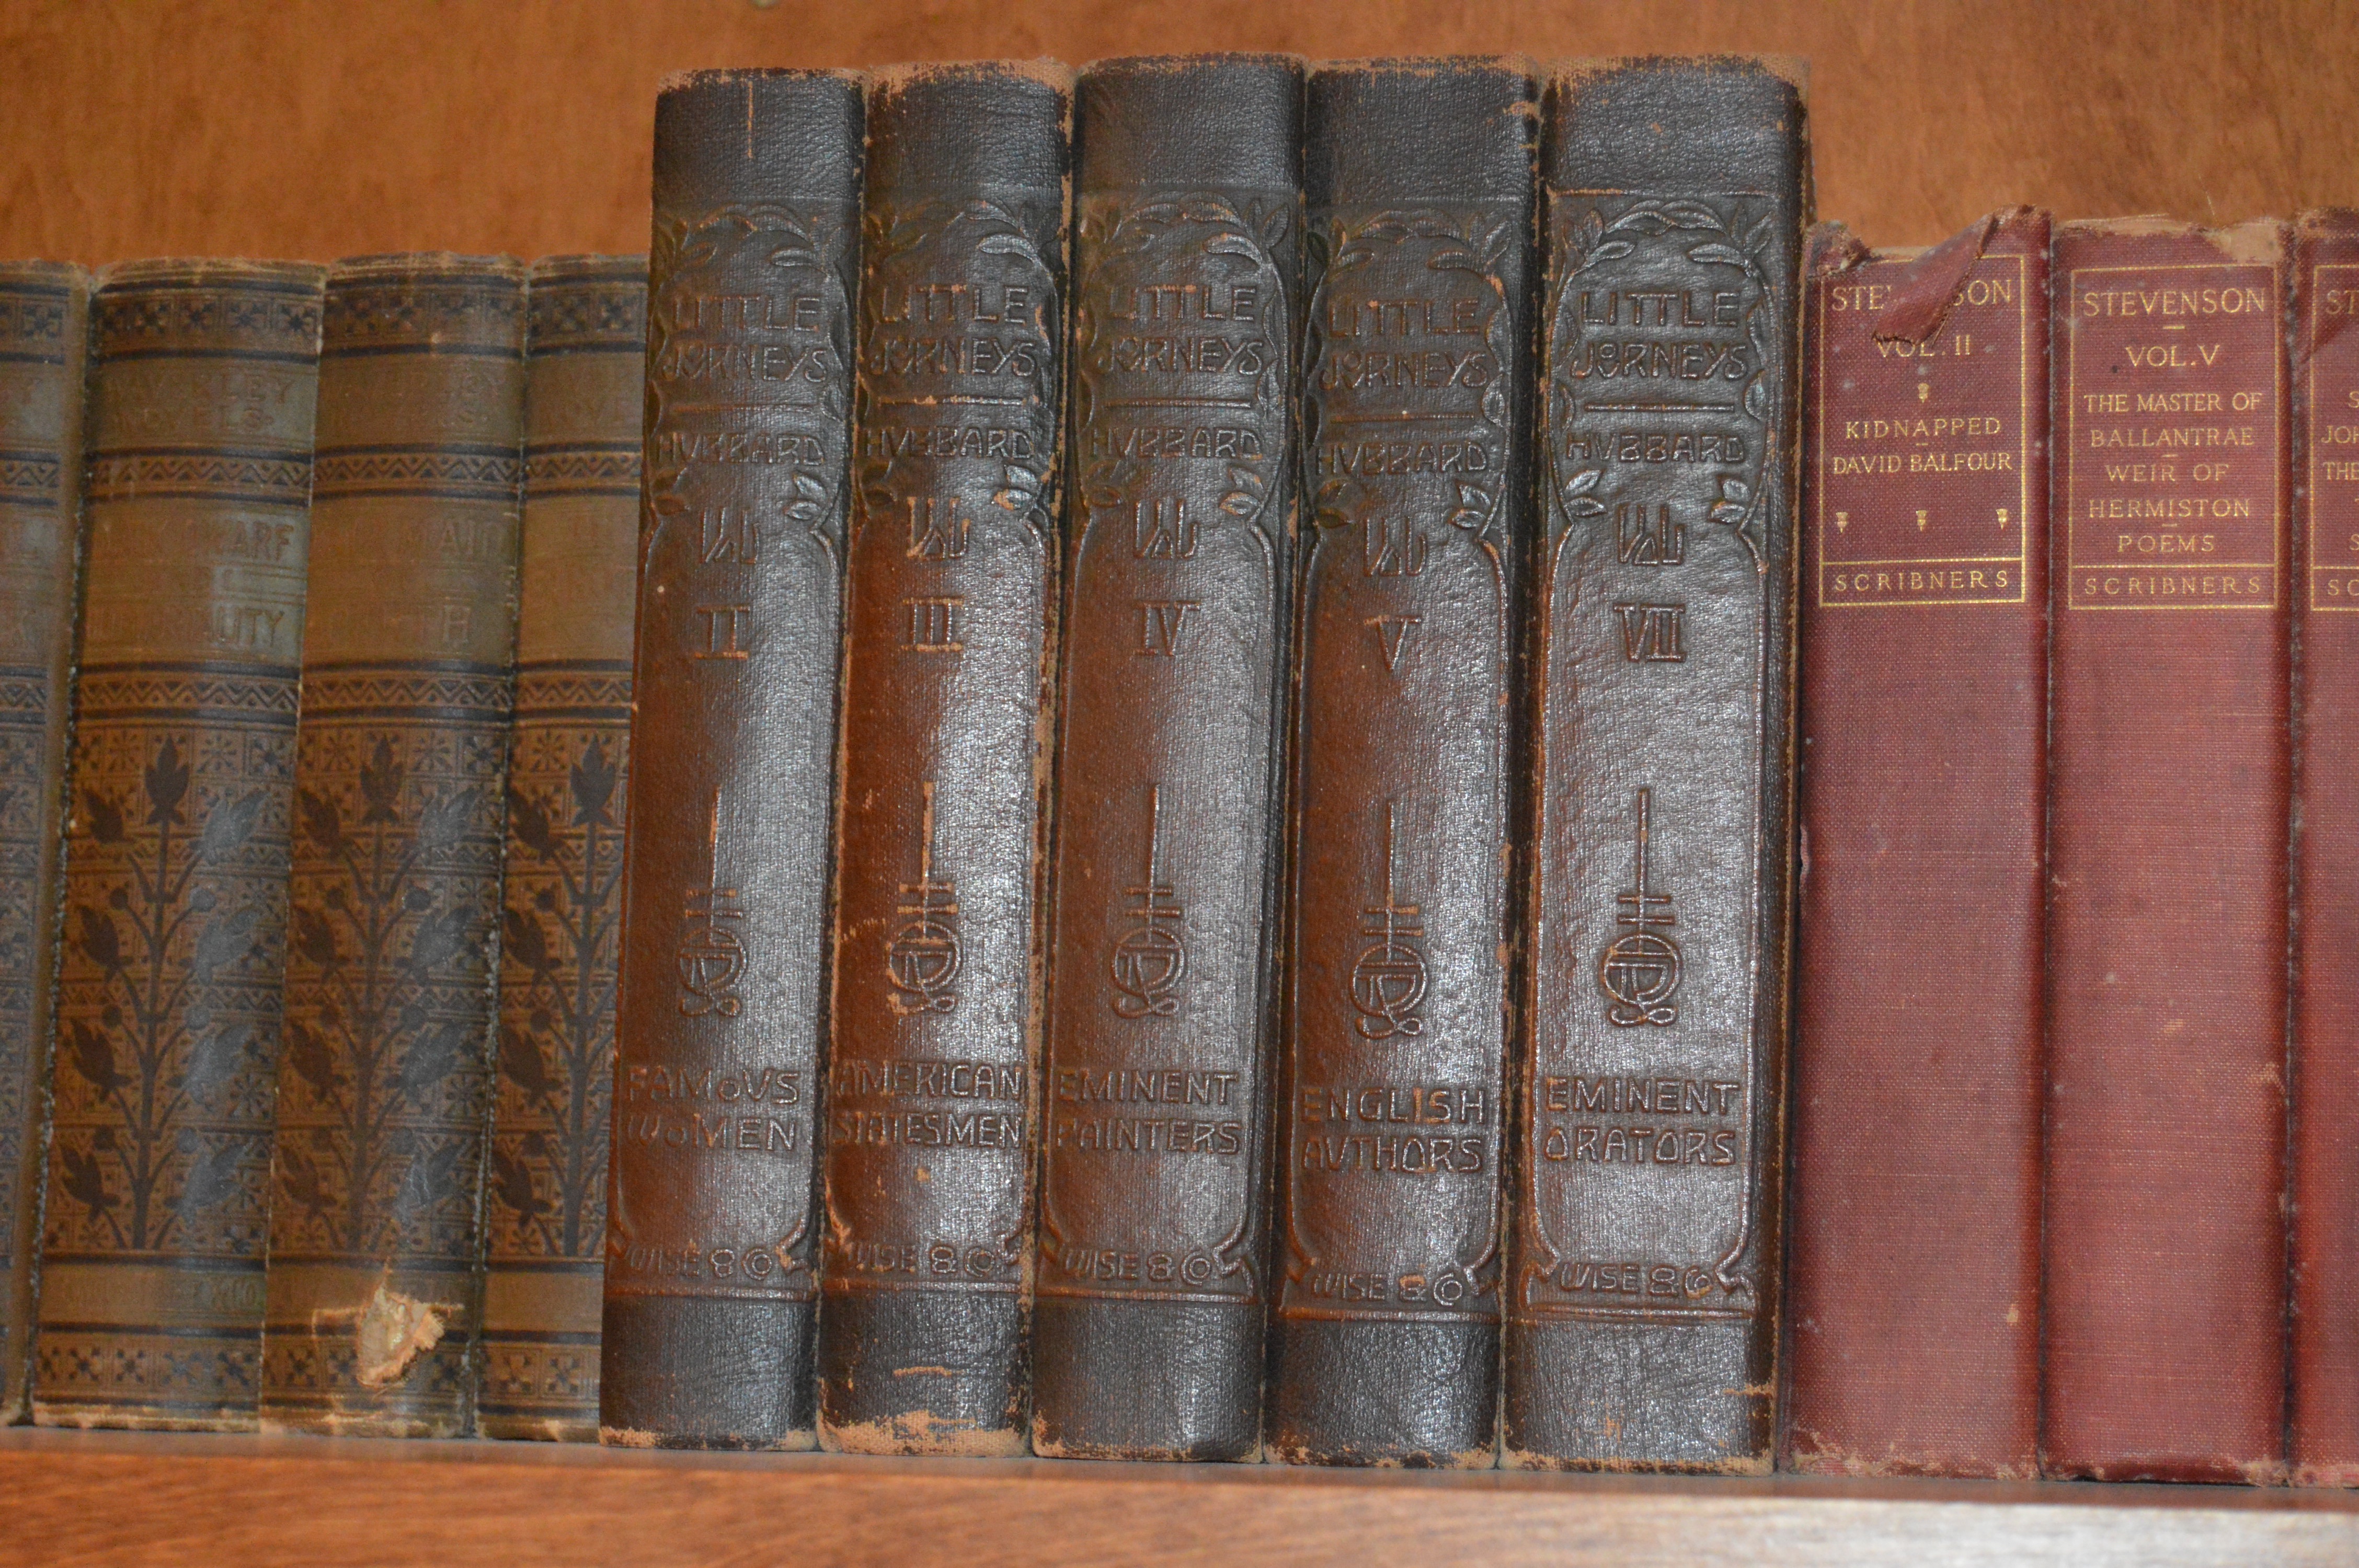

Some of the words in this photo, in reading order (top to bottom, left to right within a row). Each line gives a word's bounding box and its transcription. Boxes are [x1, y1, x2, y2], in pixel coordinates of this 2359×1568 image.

[671, 295, 821, 335] LITTLE
[880, 284, 1029, 327] LITTLE
[1109, 284, 1256, 322] LITTLE
[1327, 296, 1480, 337] LITTLE
[1579, 291, 1739, 327] LITTLE
[2083, 287, 2266, 317] STEVENSON
[2083, 394, 2129, 413] THE
[2136, 393, 2223, 412] MASTER
[2232, 391, 2263, 411] OF
[1846, 417, 2001, 439] KIDNAPPED
[2090, 428, 2254, 448] BALLANTRAE
[1832, 454, 1902, 475] DAVID
[1909, 453, 2013, 472] BALFOUR
[2104, 463, 2176, 482] WEIR
[2193, 463, 2229, 482] OF
[2088, 499, 2251, 520] HERMISTON
[2117, 535, 2215, 554] POEMS
[1835, 571, 2009, 592] SCRIBNERS
[2085, 577, 2261, 596] SCRIBNERS
[694, 604, 750, 660] II
[901, 596, 964, 652] III
[1133, 599, 1201, 657] IV
[1364, 615, 1422, 671] V
[1613, 602, 1687, 663] VII
[837, 1059, 1024, 1101] AMERICAN
[1058, 1067, 1239, 1105] EMINENT
[1545, 1075, 1740, 1115] EMINENT
[1300, 1085, 1484, 1124] ENGLISH
[835, 1108, 1023, 1149] STATESMEN
[1055, 1118, 1242, 1155] PAINTERS
[1543, 1126, 1736, 1166] ORATORS
